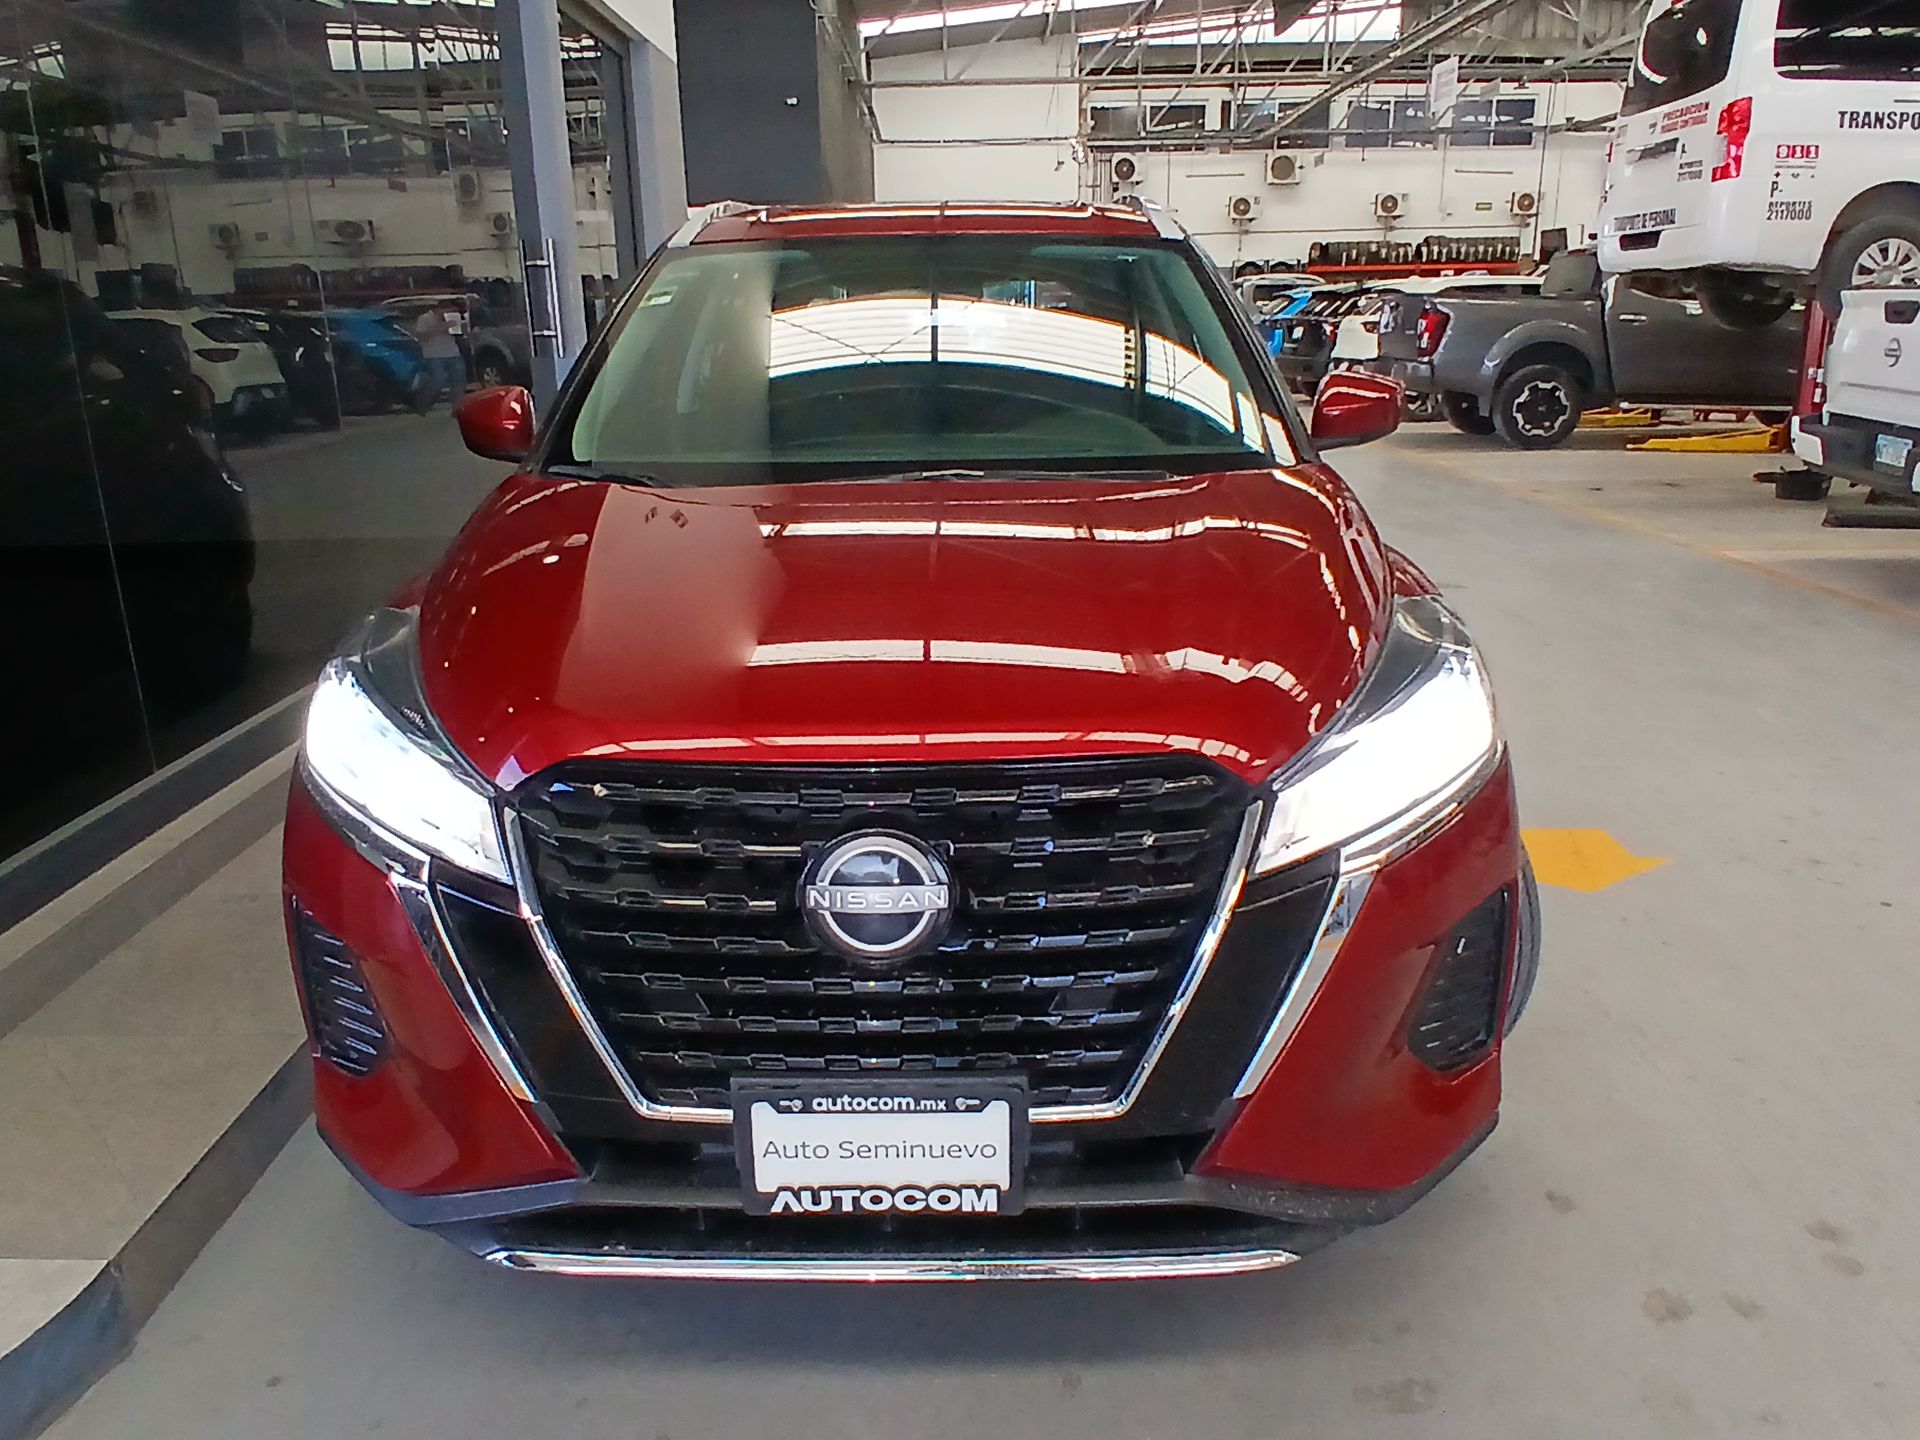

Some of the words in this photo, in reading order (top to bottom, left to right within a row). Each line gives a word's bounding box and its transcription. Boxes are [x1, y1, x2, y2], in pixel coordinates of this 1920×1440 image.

[1838, 110, 1920, 130] TRANSPO
[1777, 144, 1819, 159] 911
[1766, 208, 1812, 221] 2117000
[808, 888, 946, 909] NISSAN
[812, 1095, 947, 1112] autocom.mx
[763, 1141, 829, 1159] Auto
[838, 1140, 997, 1159] Seminuevo
[770, 1188, 998, 1213] AUTOCOM
